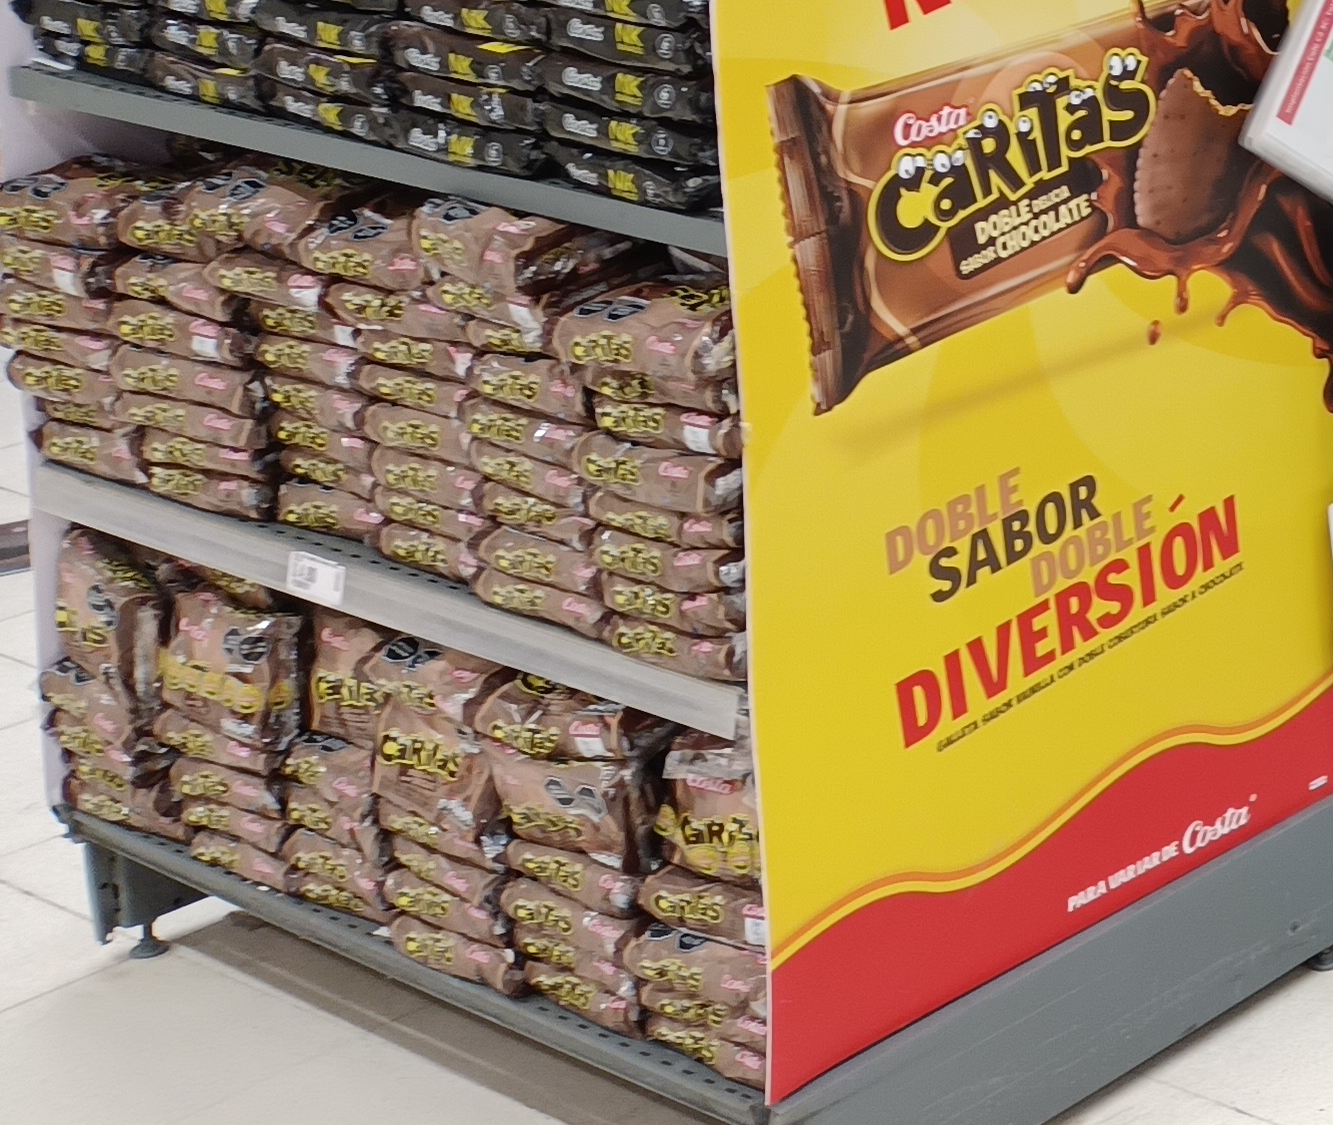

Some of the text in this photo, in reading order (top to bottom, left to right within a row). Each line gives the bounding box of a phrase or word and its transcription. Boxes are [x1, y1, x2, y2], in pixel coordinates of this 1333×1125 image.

[894, 105, 970, 147] Costa
[974, 198, 1034, 245] DOBLE
[995, 193, 1093, 259] CHOCOLATE
[884, 467, 1025, 575] DOBLE
[928, 474, 1102, 603] SABOR
[1030, 494, 1156, 597] DOBLE
[894, 494, 1241, 750] DIVERSIÓN
[1067, 805, 1251, 913] PARA VARIAR DE Costa
